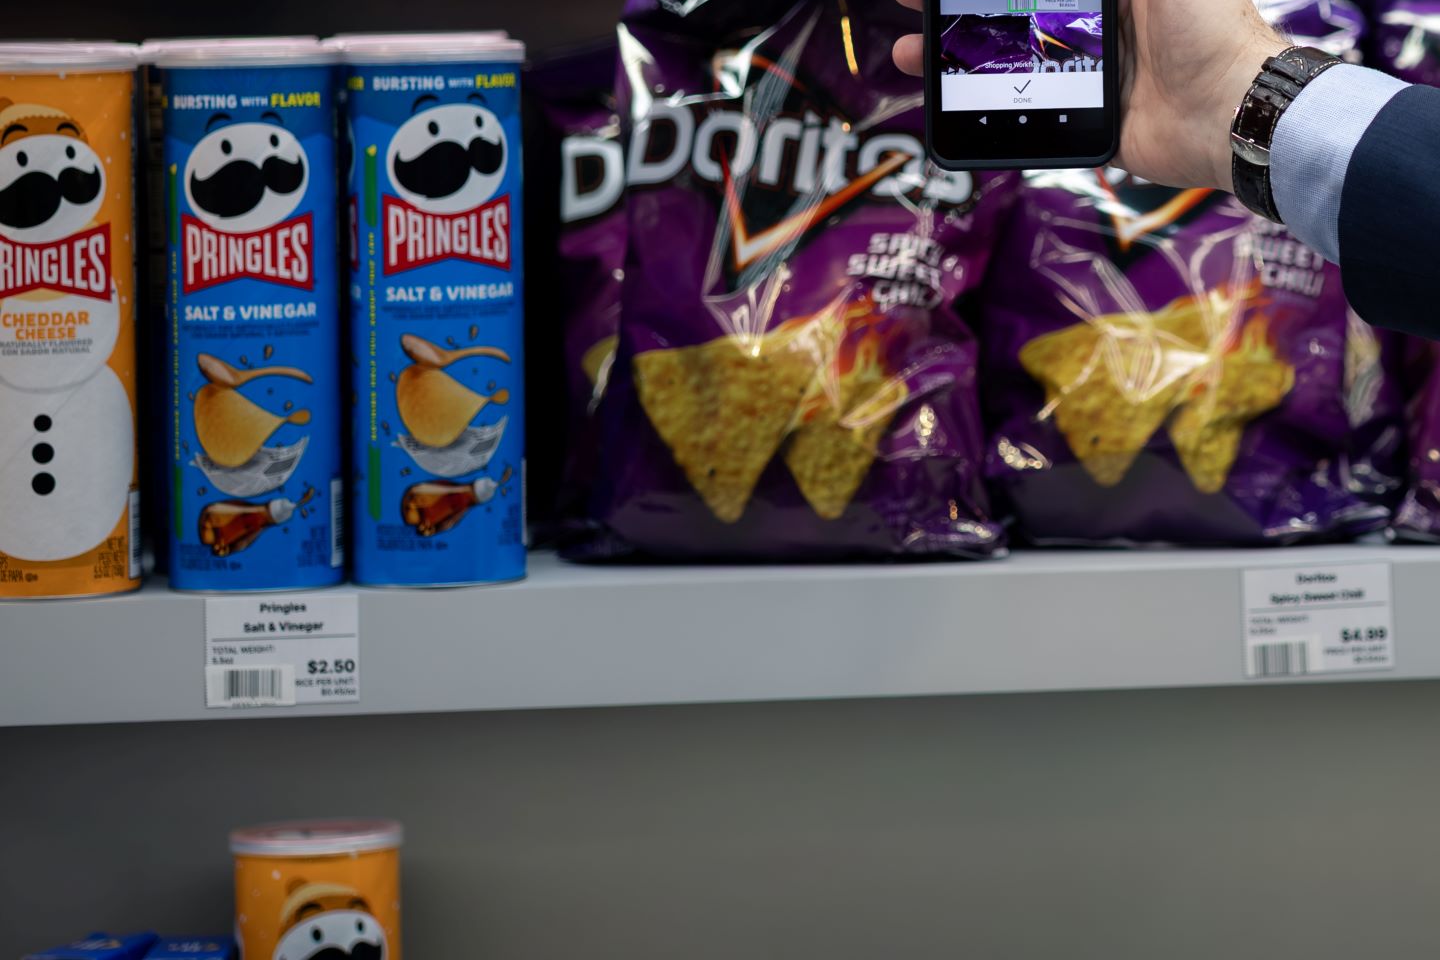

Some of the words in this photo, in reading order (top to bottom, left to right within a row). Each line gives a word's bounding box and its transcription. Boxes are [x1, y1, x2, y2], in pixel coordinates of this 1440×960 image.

[984, 62, 1012, 70] Shopping
[373, 76, 444, 91] BURSTING
[448, 78, 473, 89] WITH
[173, 94, 237, 110] BURSTING
[241, 96, 268, 107] WITH
[270, 91, 320, 109] FLAVOR
[388, 203, 507, 267] PRINGLES
[186, 222, 308, 286] PRINGLES
[0, 233, 106, 294] RINGLES
[1261, 262, 1324, 298] CHILI
[386, 286, 425, 302] SALT
[430, 286, 442, 302] &
[2, 310, 89, 327] CHEDDAR
[185, 304, 219, 320] SALT
[223, 304, 235, 320] &
[240, 302, 316, 320] VINEGAR
[15, 327, 77, 340] CHEESE
[260, 602, 306, 615] Pringles
[244, 622, 265, 633] Salt
[268, 621, 277, 632] &
[279, 619, 324, 634] Vinegar
[212, 645, 238, 655] TOTAL
[307, 659, 356, 676] $2.50
